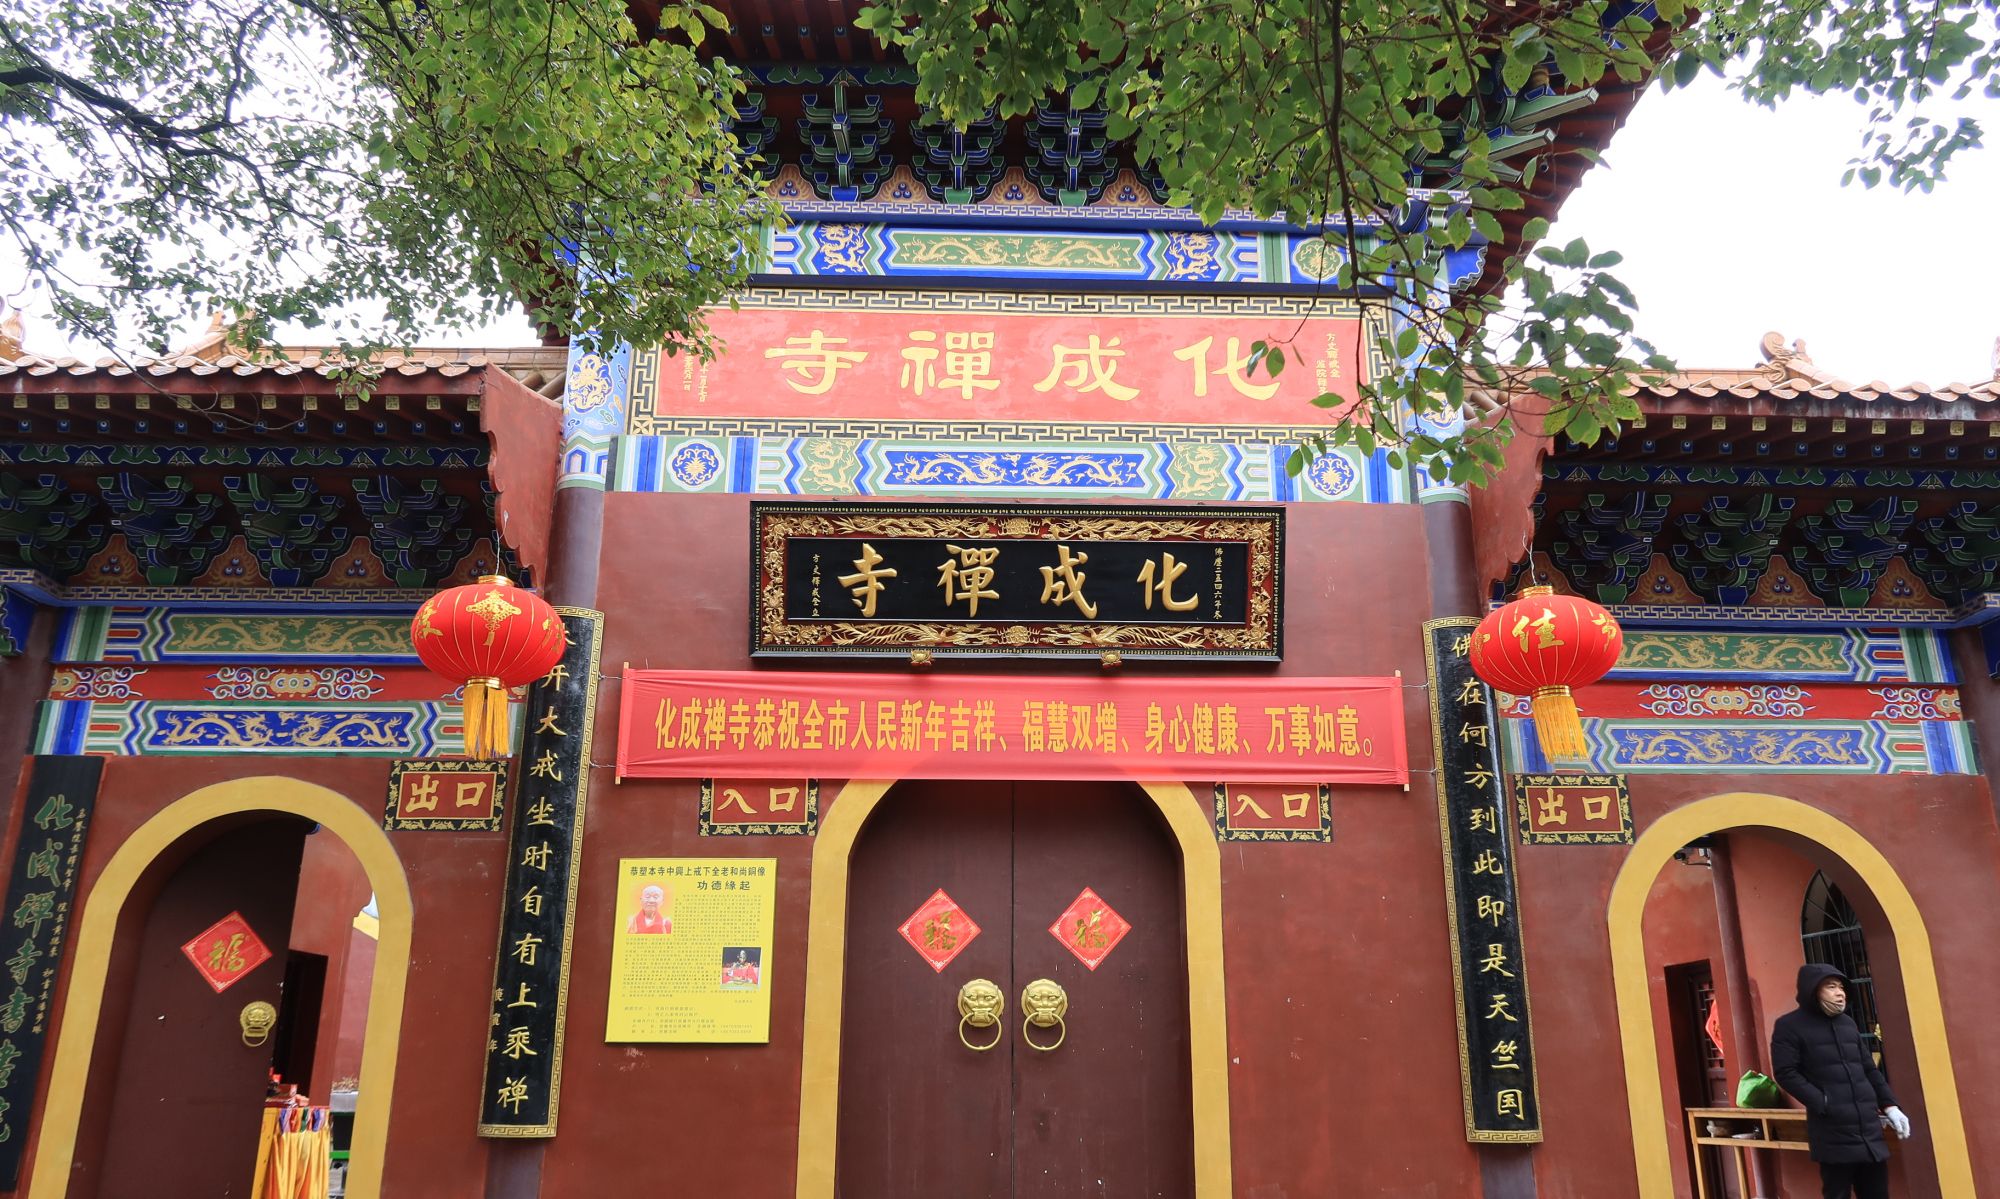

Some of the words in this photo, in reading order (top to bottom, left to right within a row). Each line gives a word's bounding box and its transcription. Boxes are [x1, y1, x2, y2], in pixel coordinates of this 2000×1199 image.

[764, 329, 1281, 400] 化成禪寺
[837, 542, 1199, 618] 化成禪寺
[405, 774, 487, 813] 出口
[717, 786, 800, 815] 入口
[1233, 793, 1311, 820] 入口
[1537, 787, 1612, 826] 出口
[497, 623, 576, 1115] 开大戒坐时自有上乘禅
